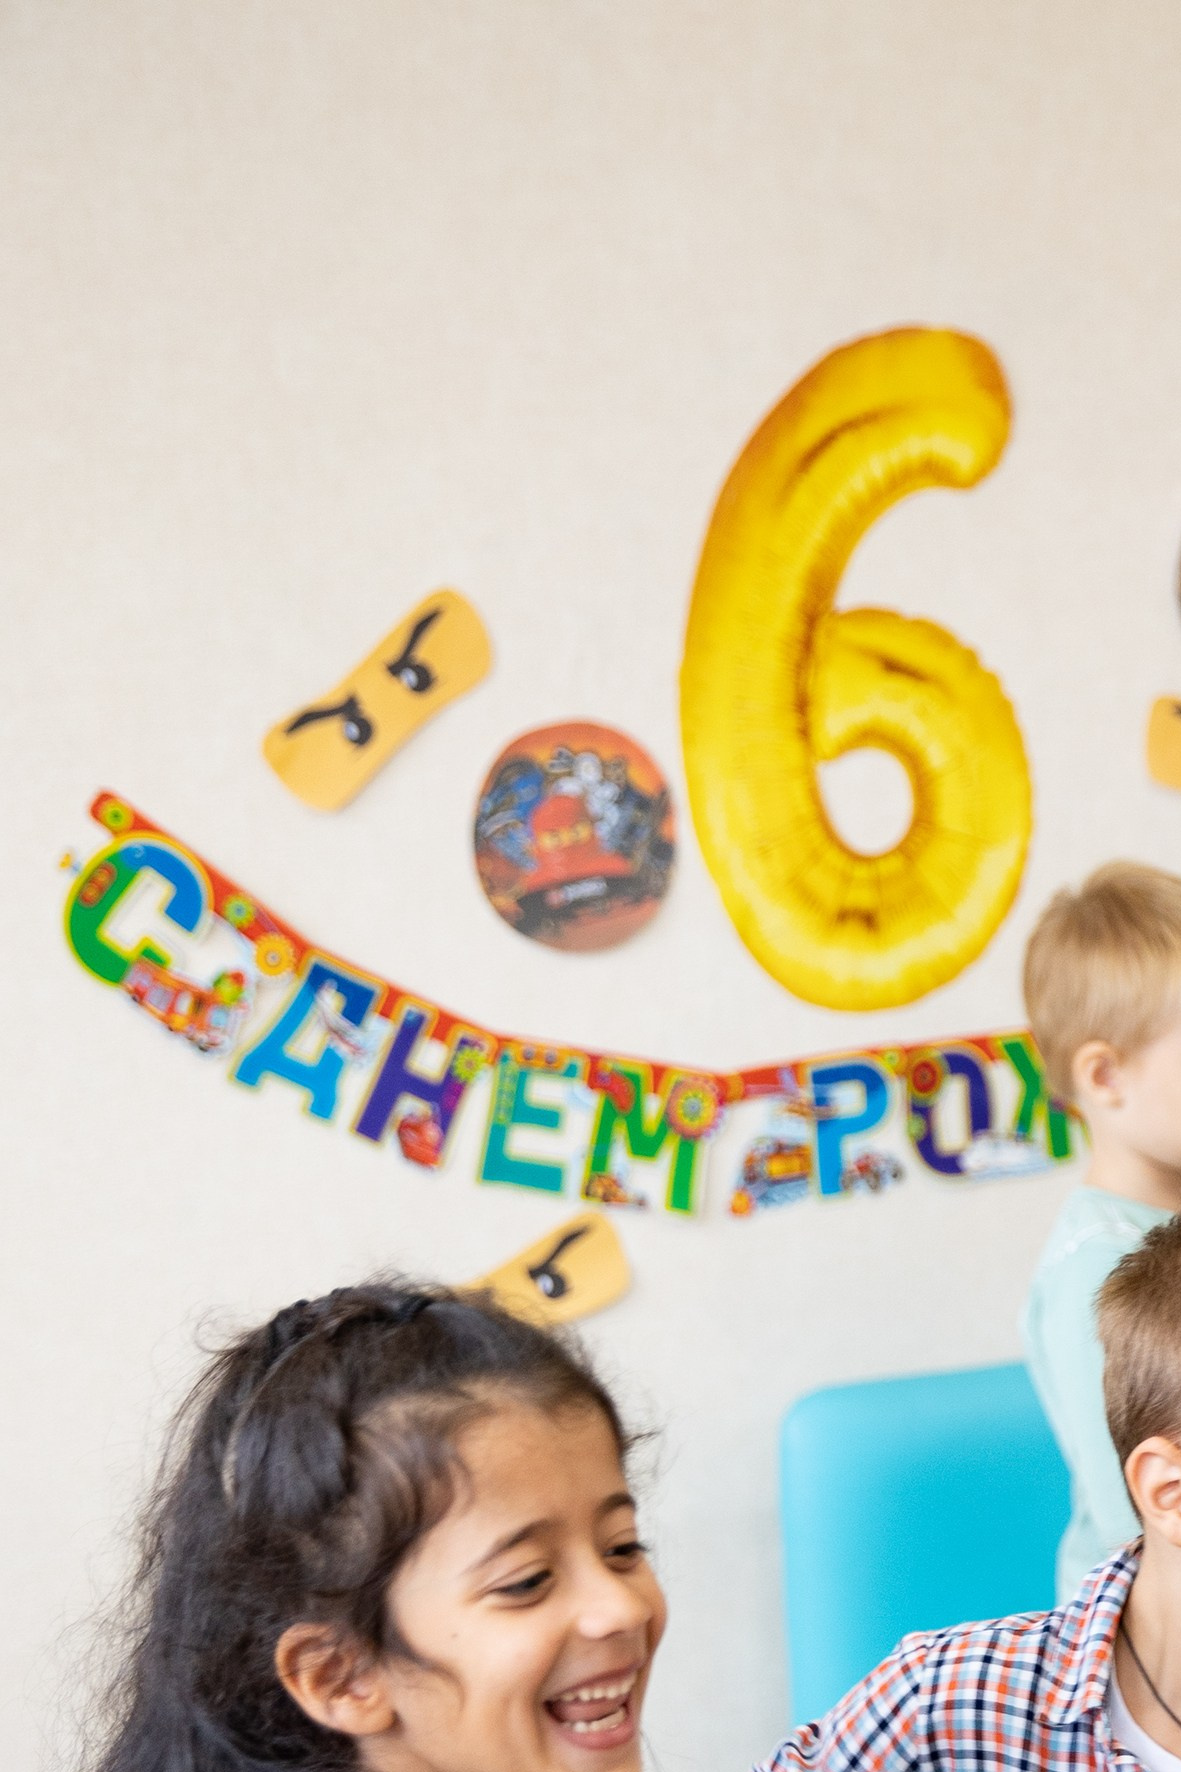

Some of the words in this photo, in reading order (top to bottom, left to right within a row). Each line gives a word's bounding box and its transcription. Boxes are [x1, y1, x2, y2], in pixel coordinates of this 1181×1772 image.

[681, 325, 1033, 1011] 6
[65, 834, 212, 988] С
[233, 958, 711, 1216] ДНЕМ
